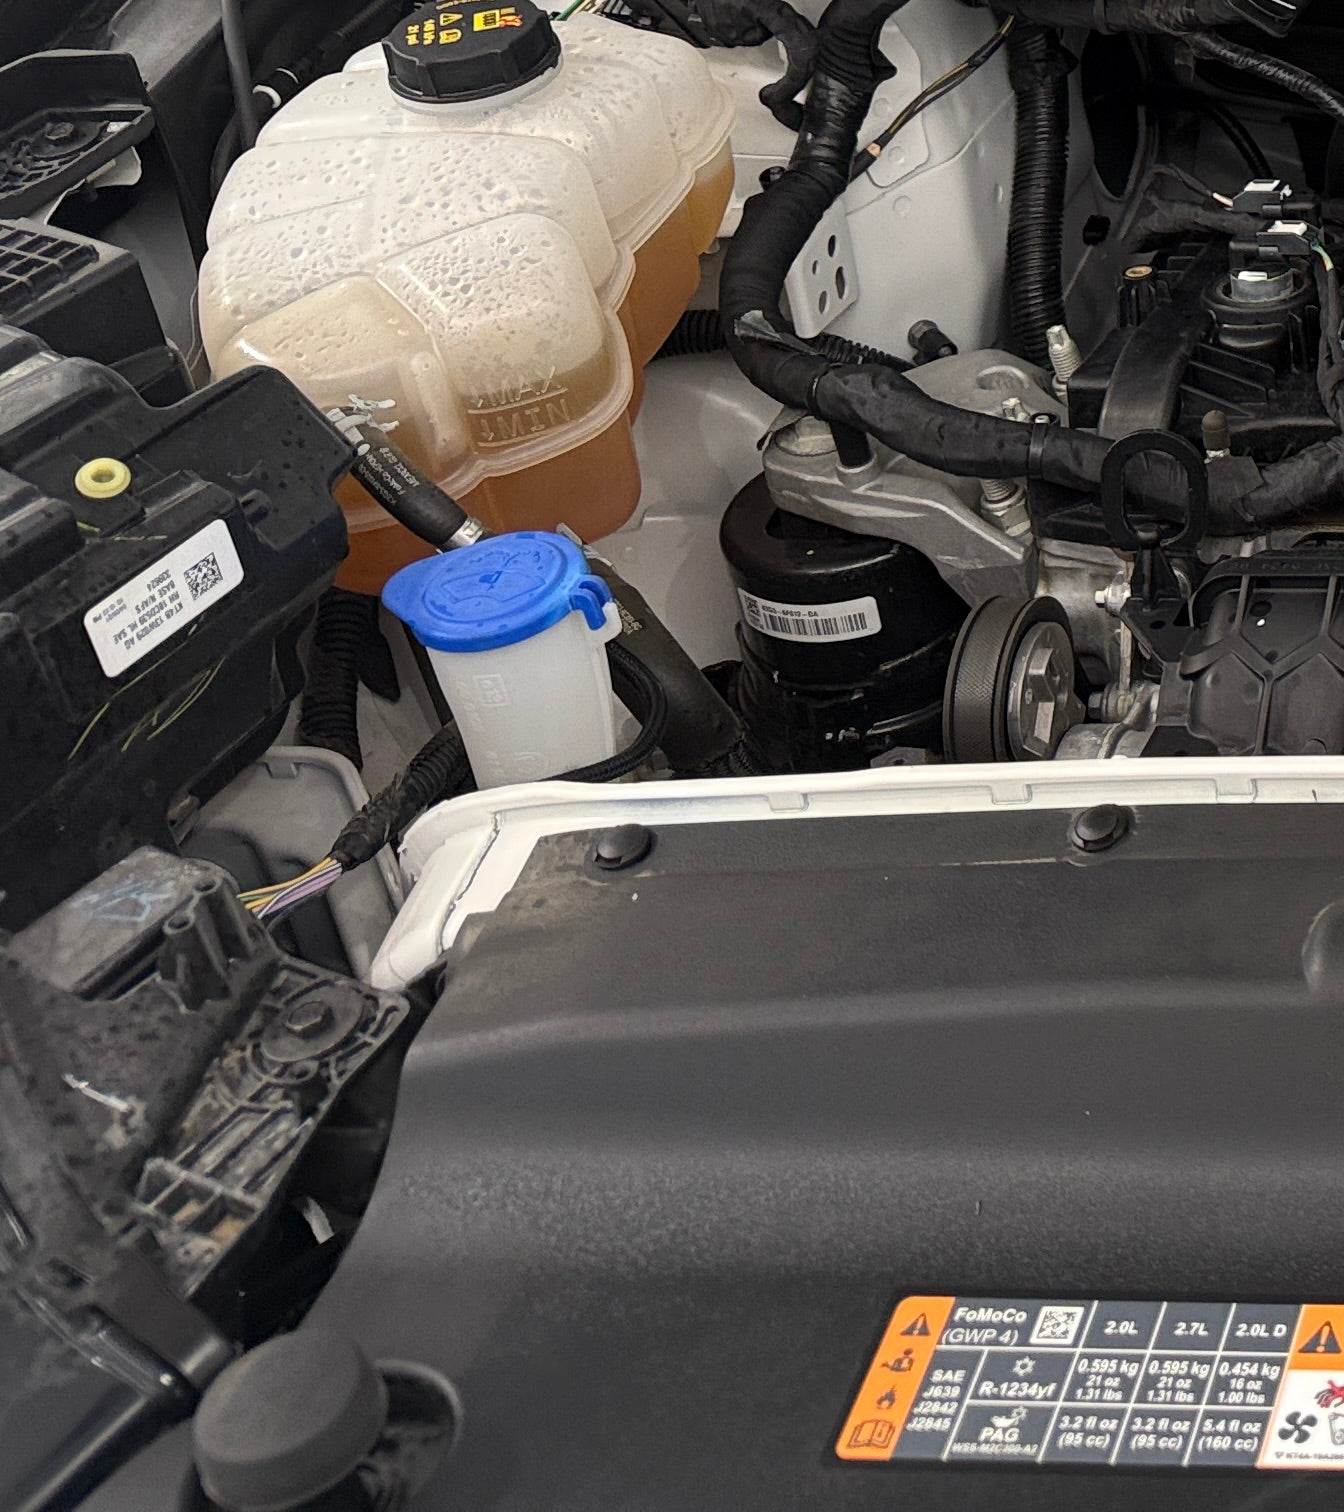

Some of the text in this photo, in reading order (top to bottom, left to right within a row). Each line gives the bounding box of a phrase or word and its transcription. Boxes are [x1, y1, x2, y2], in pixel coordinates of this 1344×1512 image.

[487, 365, 561, 406] MAX
[496, 398, 571, 439] MIN
[157, 580, 176, 598] BASE
[112, 630, 128, 644] SAE
[953, 1306, 1027, 1323] FoMoCo
[1104, 1321, 1138, 1335] 2.0L
[1174, 1322, 1209, 1337] 2.7L
[1235, 1323, 1287, 1338] 2.0L D
[941, 1328, 1019, 1346] (GWP 4)
[1077, 1359, 1140, 1377] 0.595 kg
[1148, 1360, 1211, 1378] 0.595 kg
[1219, 1362, 1281, 1380] 0.454 kg
[931, 1369, 966, 1383] SAE
[1086, 1375, 1120, 1387] 21 oz
[1157, 1377, 1192, 1388] 21 oz
[979, 1381, 1057, 1399] R-1234yf
[1230, 1378, 1262, 1390] 16 oz
[1075, 1388, 1123, 1401] 1.31 lbs
[1147, 1390, 1194, 1403] 1.31 lbs
[1218, 1391, 1265, 1404] 1.00 lbs
[1058, 1416, 1119, 1431] 3.2 fl oz
[1130, 1417, 1191, 1432] 3.2 fl oz
[1203, 1419, 1261, 1433] 5.4 fl oz
[978, 1428, 1020, 1442] PAG
[1058, 1432, 1110, 1448] (95 cc)
[1130, 1434, 1183, 1450] (95 cc)
[1198, 1436, 1259, 1452] (160 cc)
